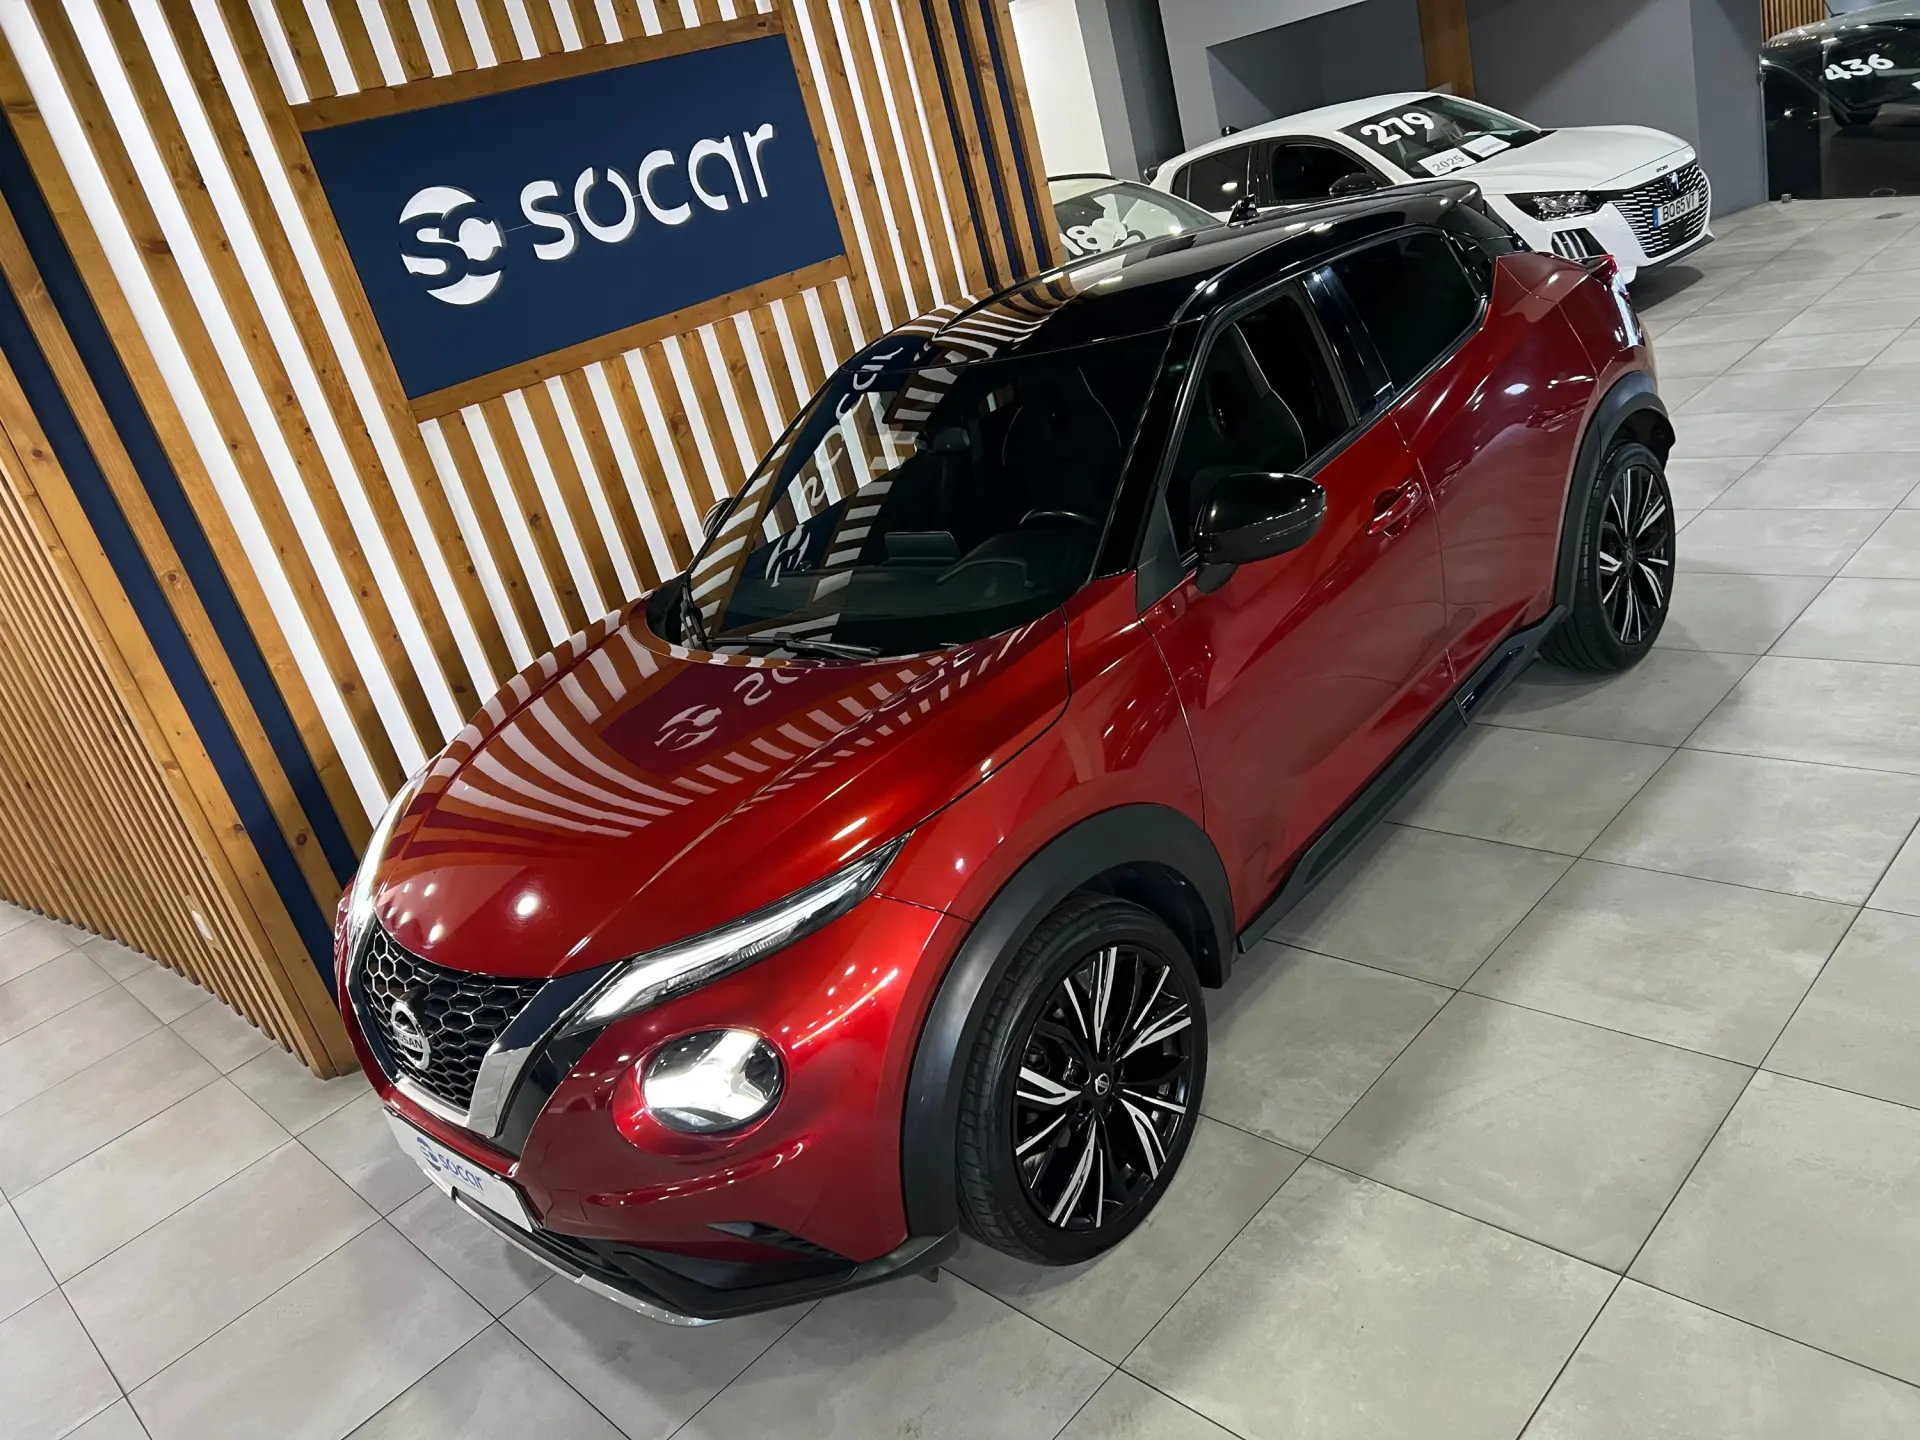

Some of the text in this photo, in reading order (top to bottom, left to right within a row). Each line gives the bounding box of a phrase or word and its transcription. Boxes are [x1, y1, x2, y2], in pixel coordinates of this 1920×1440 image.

[1825, 53, 1894, 81] 436
[1360, 112, 1435, 145] 279
[1431, 155, 1465, 172] 2025
[519, 123, 774, 261] socar
[394, 1029, 424, 1050] SSAN
